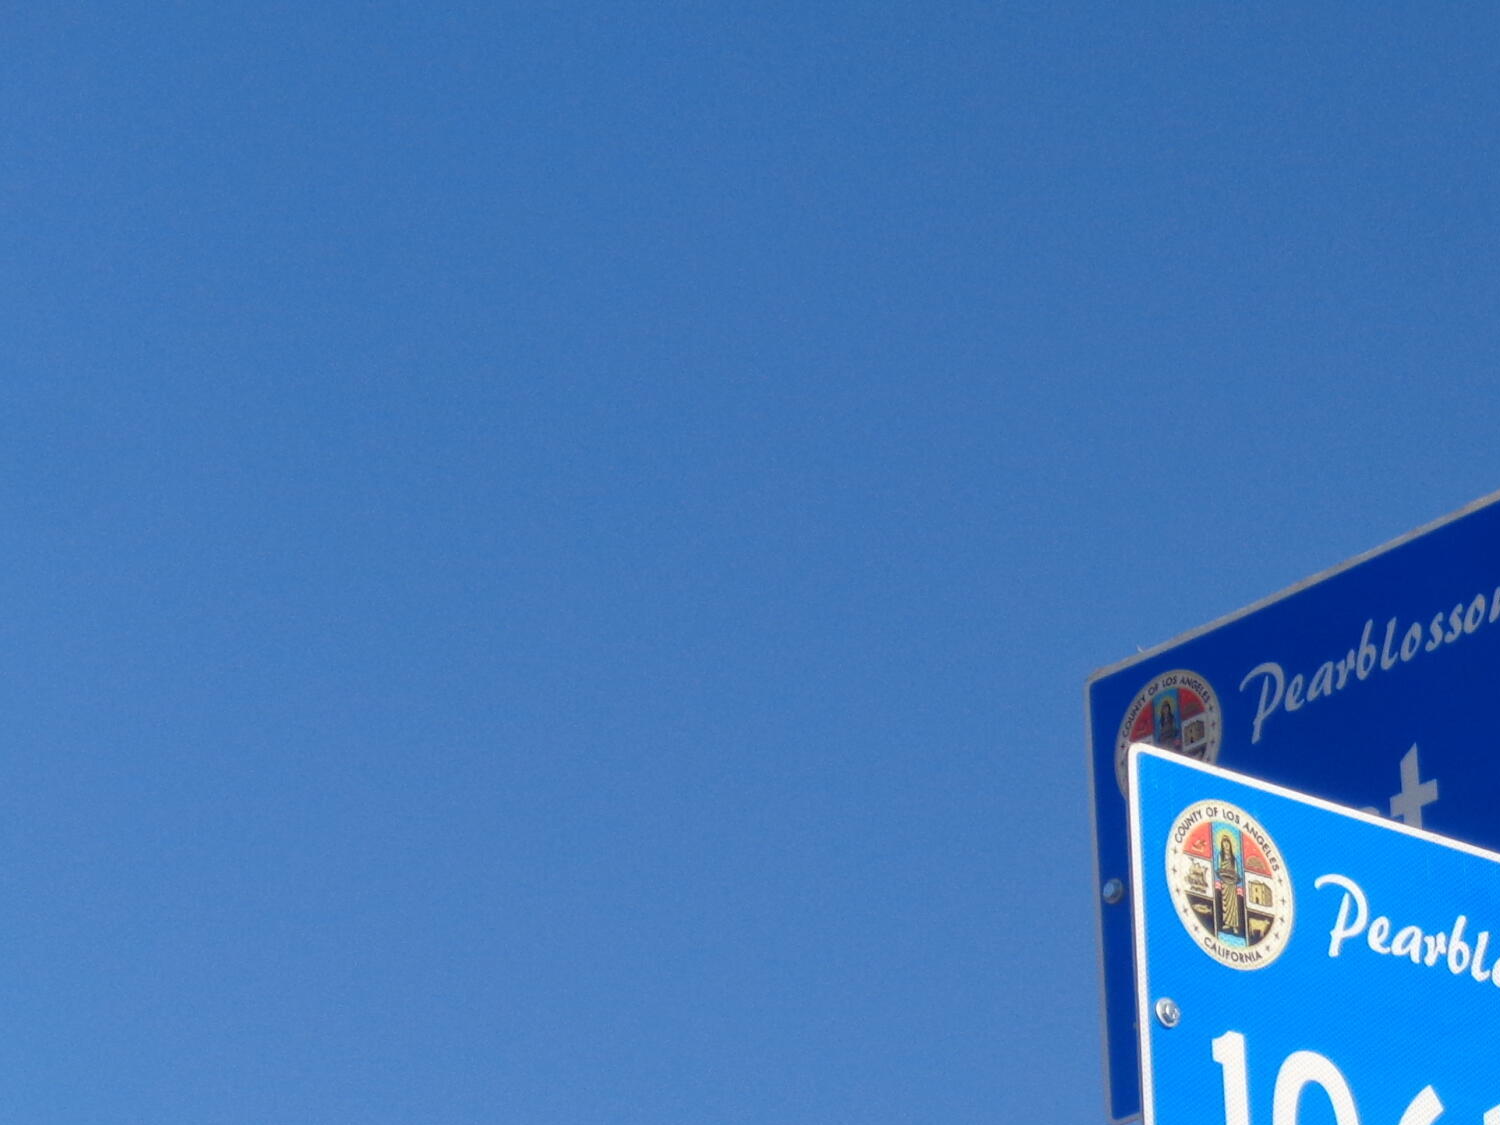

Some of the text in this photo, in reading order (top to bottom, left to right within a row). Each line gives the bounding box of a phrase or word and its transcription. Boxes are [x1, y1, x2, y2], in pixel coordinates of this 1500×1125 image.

[1122, 675, 1210, 737] COUNTY OF LOS ANGELES
[1174, 806, 1280, 872] COUNTY OF LOS ANGELES
[1204, 936, 1263, 963] CALIFORNIA
